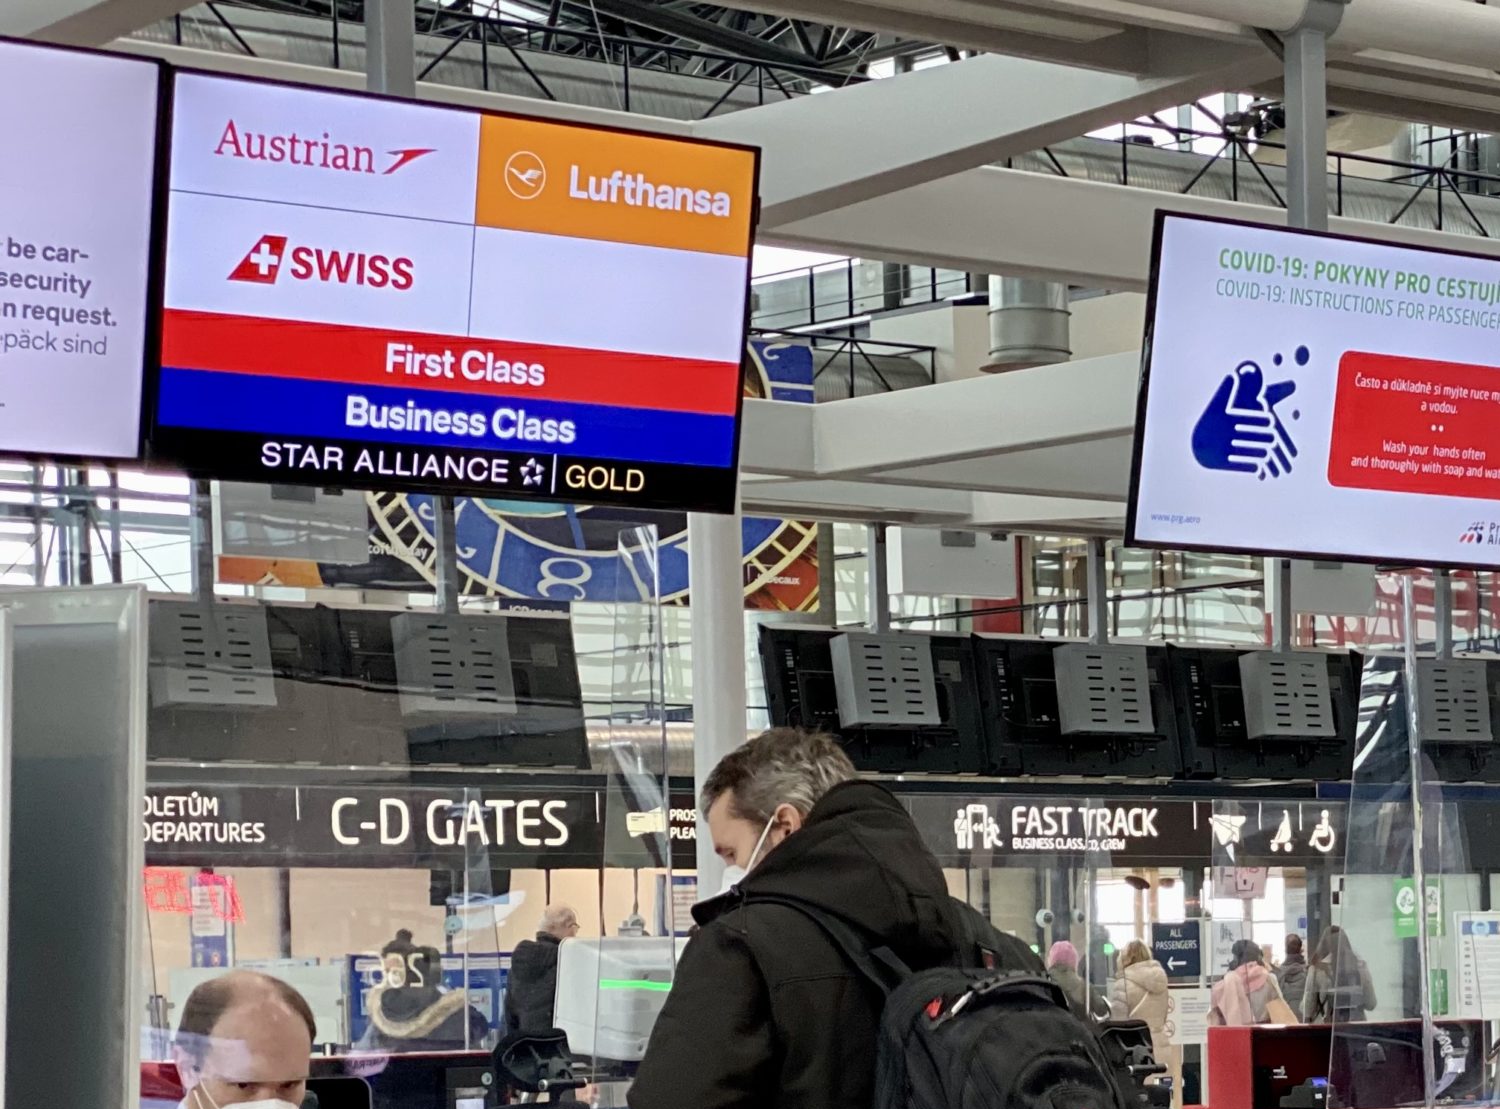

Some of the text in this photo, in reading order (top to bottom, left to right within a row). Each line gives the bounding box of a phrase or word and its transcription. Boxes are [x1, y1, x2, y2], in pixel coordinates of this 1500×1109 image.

[214, 119, 375, 175] Austrian
[568, 163, 731, 218] Lufthansa
[7, 236, 89, 264] be car-
[290, 245, 415, 292] SWISS
[1219, 247, 1308, 279] COVID-19:
[1313, 260, 1389, 289] POKYNY
[1394, 270, 1430, 294] PRO
[1215, 277, 1285, 303] COVID-19:
[1289, 287, 1394, 316] INSTRUCTIONS
[1396, 300, 1424, 320] FOR
[22, 304, 117, 327] request.
[63, 334, 107, 356] sind
[385, 342, 546, 388] First Class
[1354, 371, 1380, 389] Často
[1380, 379, 1390, 390] a
[1389, 378, 1431, 394] důkladně
[1433, 384, 1441, 395] si
[1442, 385, 1468, 399] myjte
[1469, 388, 1489, 400] ruce
[345, 395, 577, 445] Business Class
[1420, 400, 1458, 414] a vodou.
[1382, 439, 1486, 460] Wash your hands often
[260, 441, 645, 494] STAR ALLIANCE GOLD
[1350, 455, 1369, 467] and
[1370, 455, 1419, 474] thoroughly
[1421, 461, 1442, 473] with
[1443, 464, 1464, 478] soap
[1465, 465, 1483, 477] and
[331, 797, 568, 847] C-D GATES
[669, 809, 697, 822] PROS
[1011, 806, 1159, 837] FAST TRACK
[669, 827, 697, 840] PLEA
[1012, 837, 1055, 850] BUSINESS
[1155, 939, 1198, 952] PASSENGERS
[1169, 928, 1183, 938] ALL
